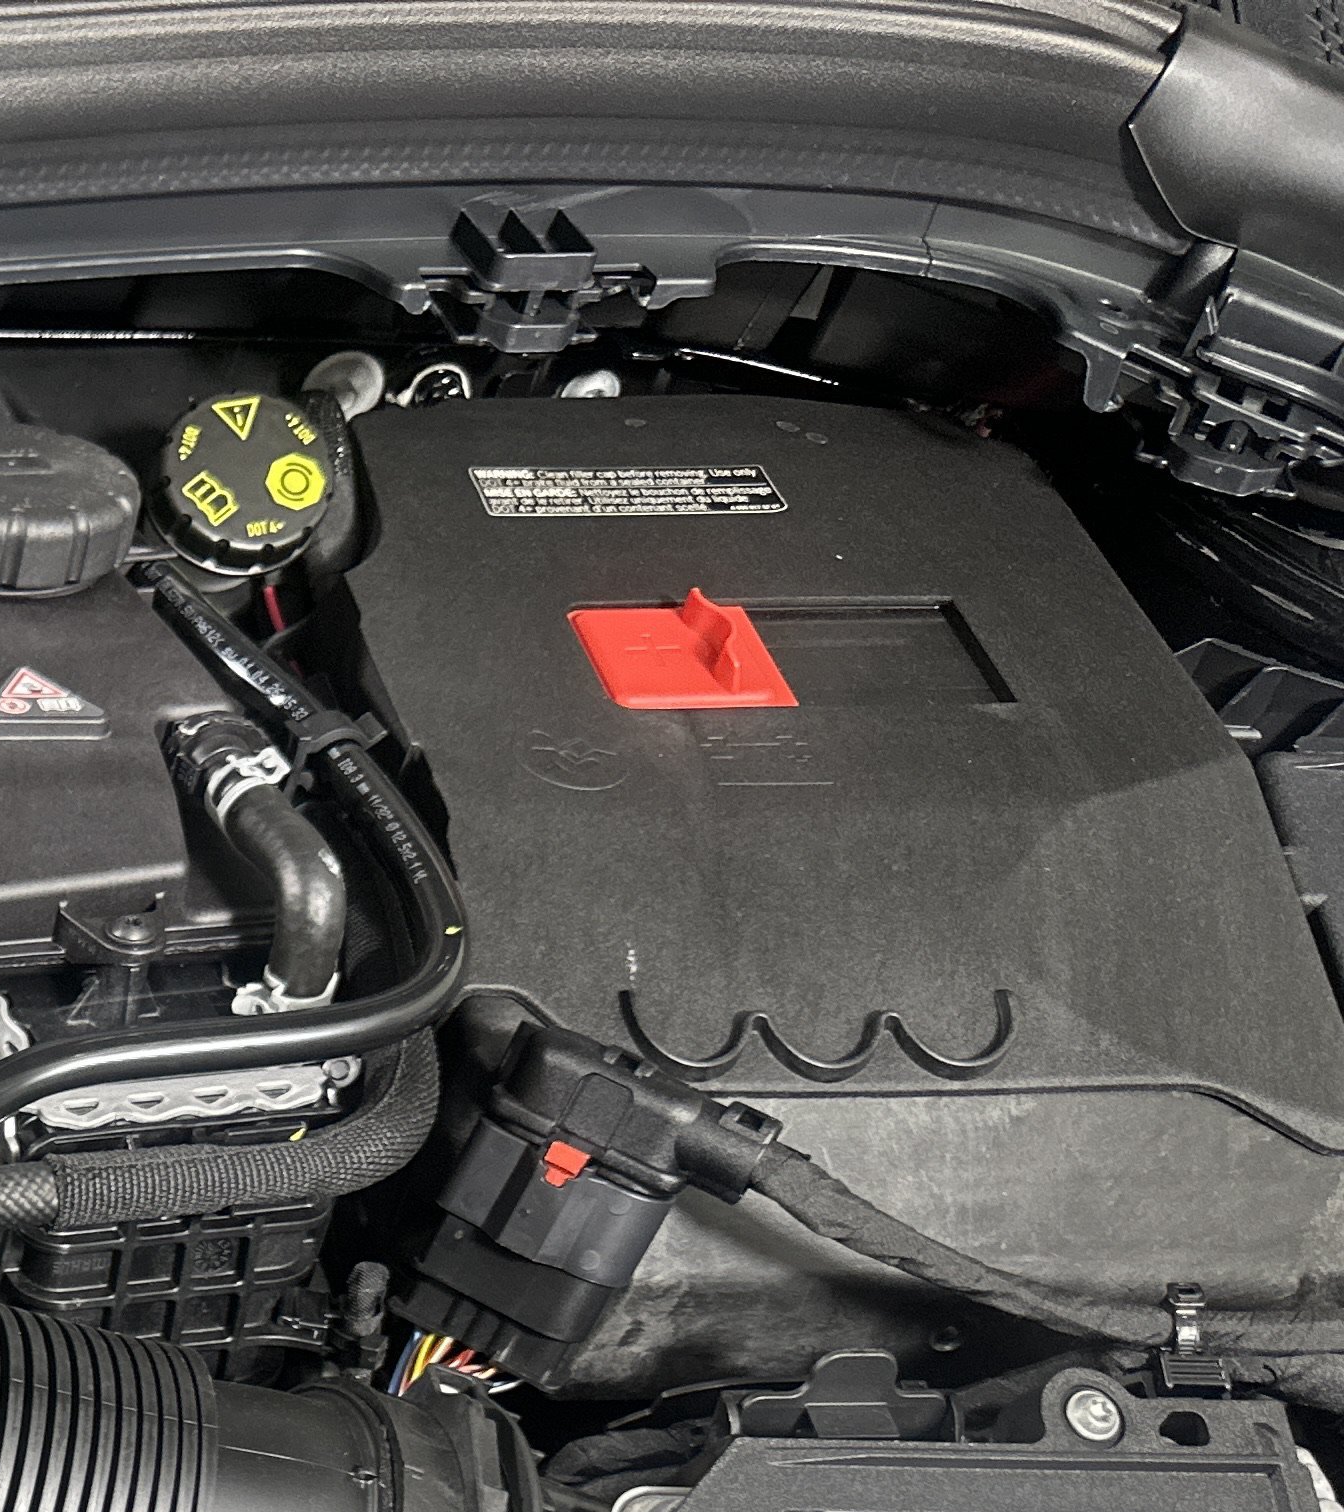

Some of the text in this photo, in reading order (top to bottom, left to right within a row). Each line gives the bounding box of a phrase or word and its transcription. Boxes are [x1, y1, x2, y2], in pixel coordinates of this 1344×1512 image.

[473, 469, 534, 479] WARNING:
[536, 470, 568, 479] Clean
[569, 469, 594, 479] filler
[595, 470, 616, 480] cap
[617, 469, 654, 478] before
[708, 468, 731, 477] Use
[733, 468, 757, 478] only
[618, 478, 654, 486] sealed
[484, 487, 772, 498] MISE EN GARDE: Nettoyez le bouchon de remplissage
[520, 497, 535, 505] de
[536, 497, 548, 505] le
[587, 497, 629, 505] Utilisez
[630, 496, 694, 504] uniquement
[696, 495, 712, 503] du
[535, 506, 590, 514] provenant
[618, 504, 674, 512] contenant
[246, 522, 267, 537] DOT
